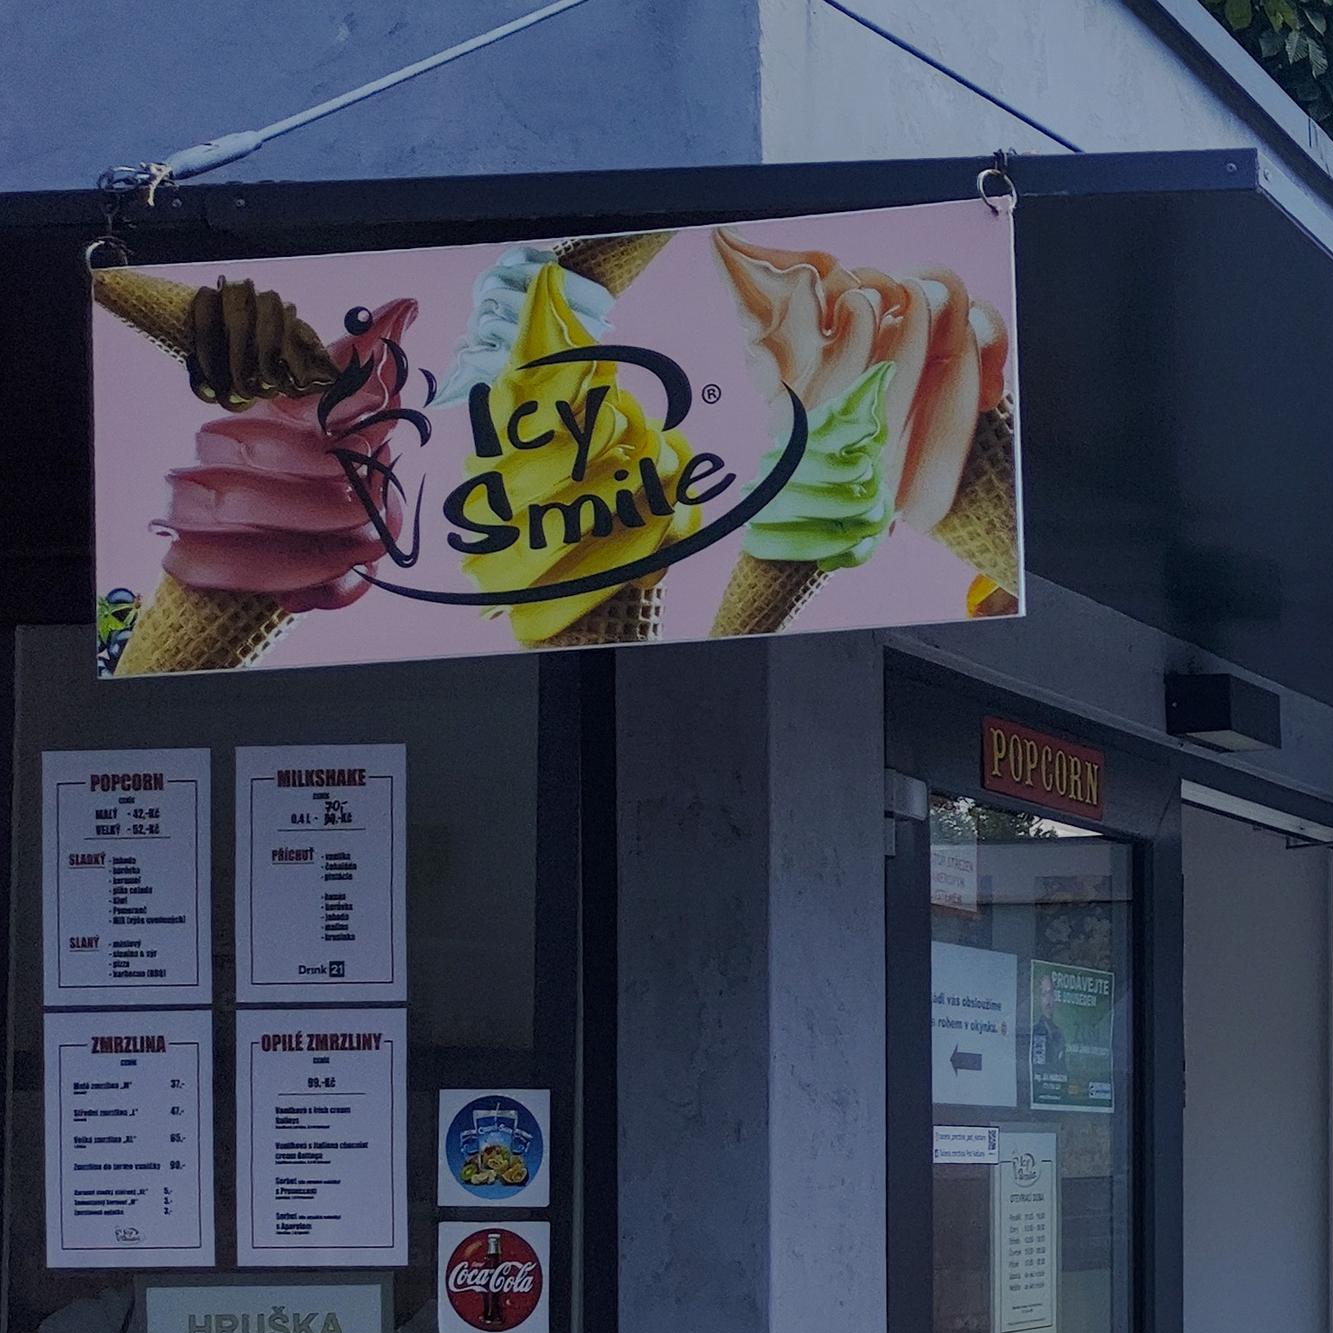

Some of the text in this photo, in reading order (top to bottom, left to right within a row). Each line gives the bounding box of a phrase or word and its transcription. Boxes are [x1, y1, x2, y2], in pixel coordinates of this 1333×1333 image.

[470, 381, 611, 482] Icy
[446, 449, 736, 555] Smile
[990, 727, 1099, 805] POPCORN
[90, 773, 165, 792] POPCORN
[277, 768, 366, 788] MILKSHAKE
[95, 824, 121, 836] VELKÝ
[69, 852, 106, 867] SLADKÝ
[271, 847, 315, 862] PŘÍCHUŤ
[69, 935, 100, 949] SLANÝ
[298, 963, 344, 976] Drink 21
[91, 1035, 166, 1054] ZMRZLINA
[261, 1031, 383, 1052] OPILÉ ZMRZLINY
